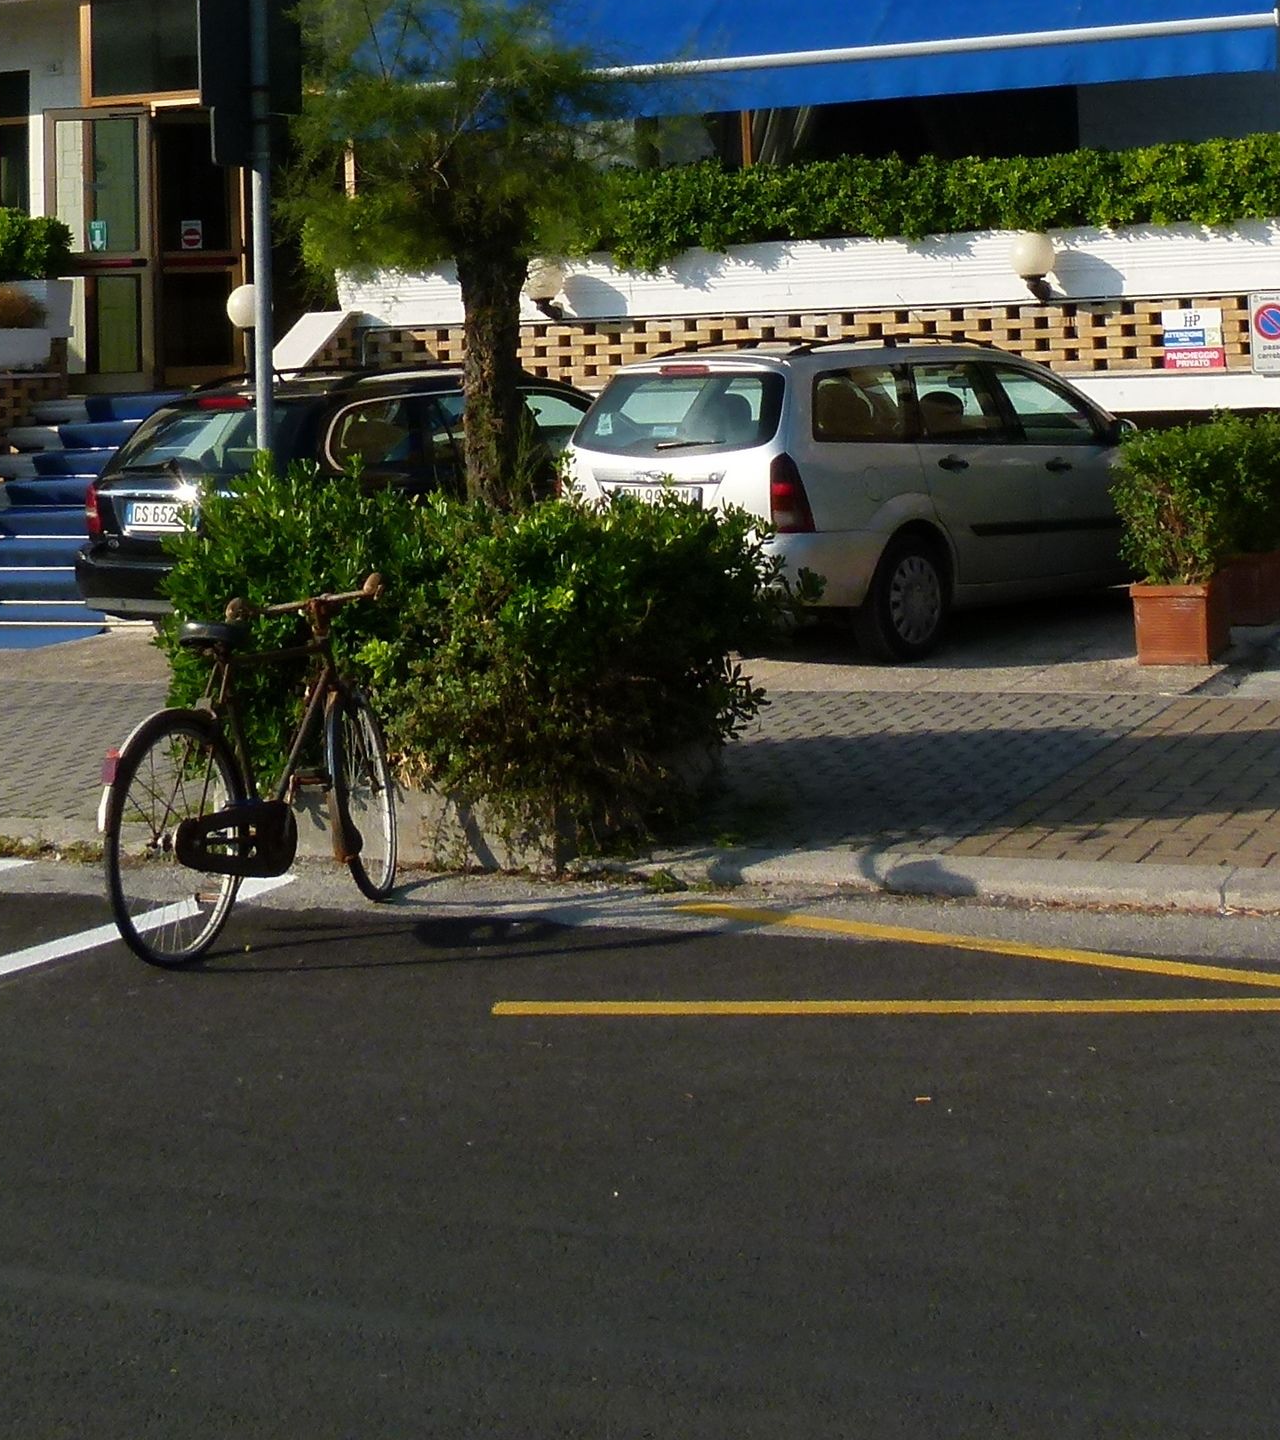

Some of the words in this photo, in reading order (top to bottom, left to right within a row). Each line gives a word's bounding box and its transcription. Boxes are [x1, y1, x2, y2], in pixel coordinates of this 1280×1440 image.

[1184, 314, 1201, 327] HP
[1166, 351, 1220, 361] PARCHEGGIO
[1175, 360, 1211, 368] PRIVATO
[134, 505, 148, 523] CS
[153, 505, 185, 523] 652
